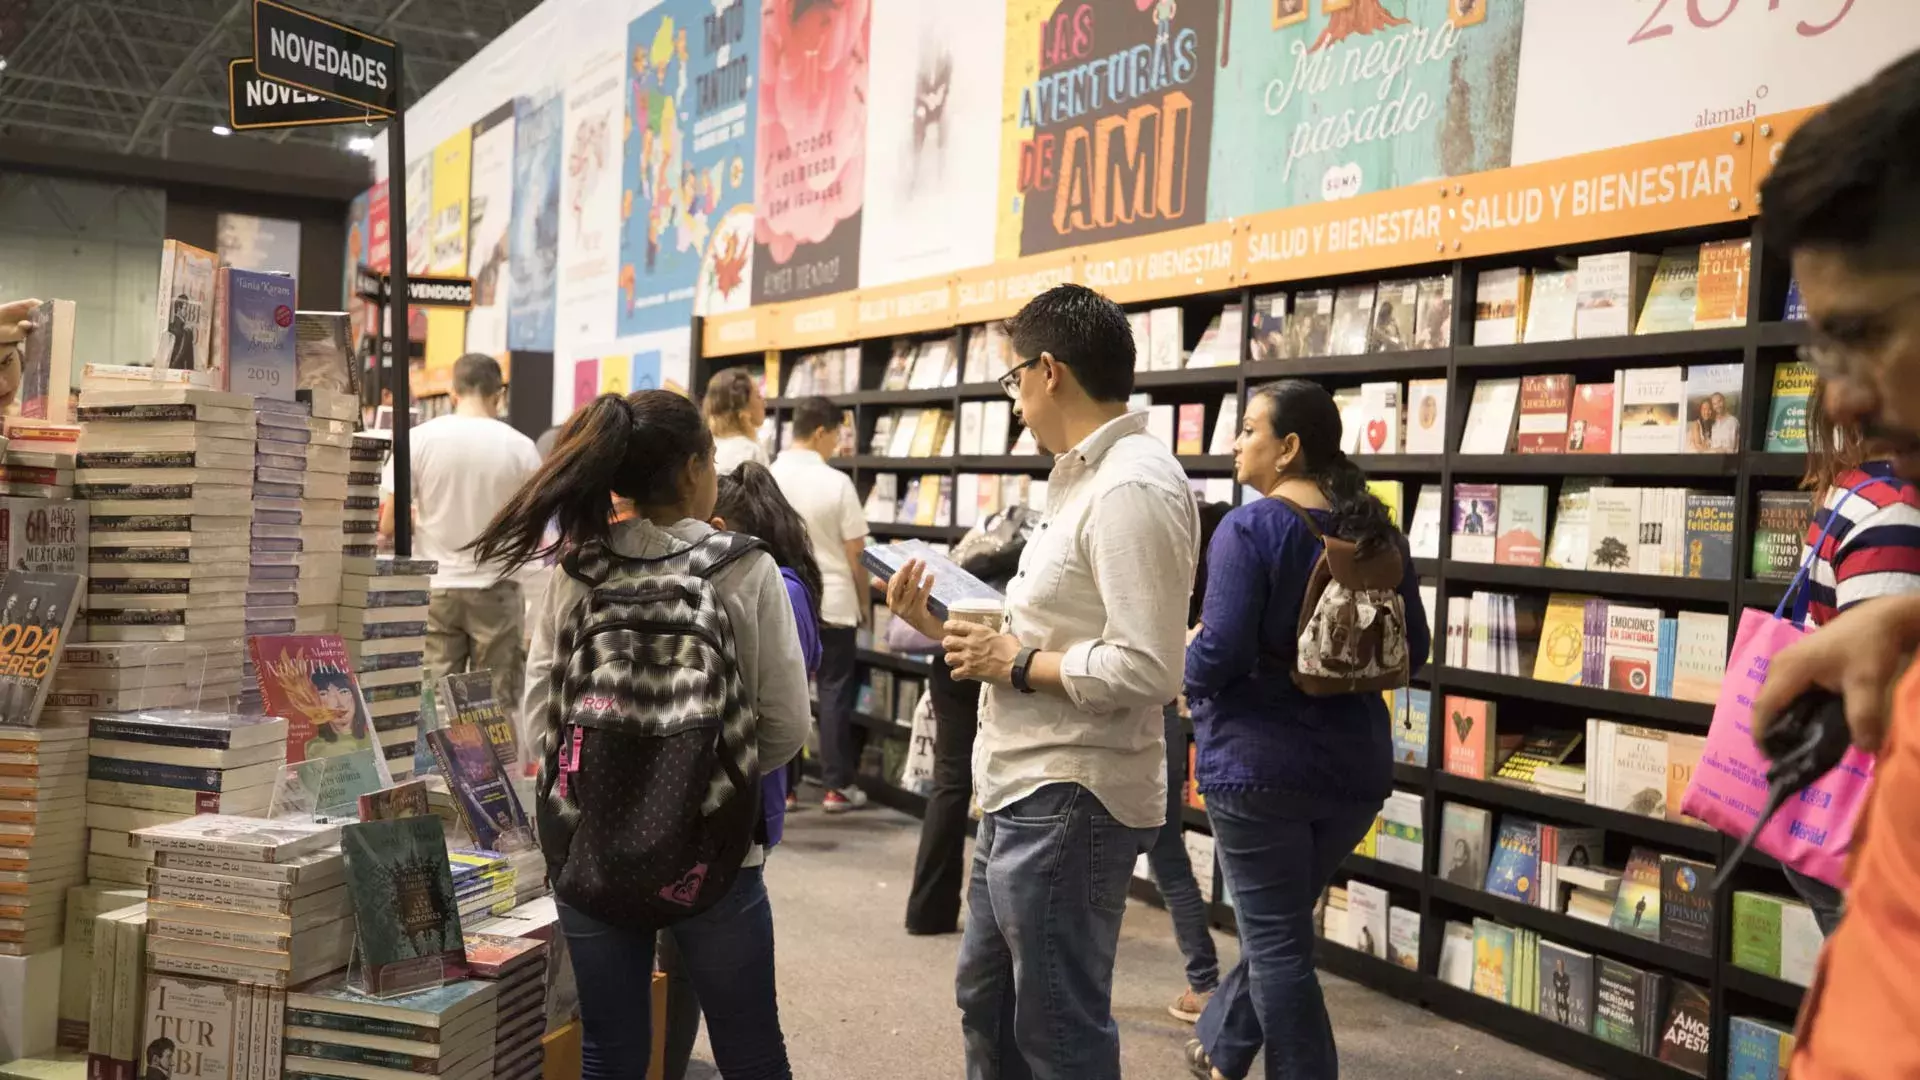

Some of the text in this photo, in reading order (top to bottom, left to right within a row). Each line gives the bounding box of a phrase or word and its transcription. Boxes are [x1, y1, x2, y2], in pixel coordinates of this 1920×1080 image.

[1039, 4, 1095, 70] LAS
[270, 27, 387, 90] NOVEDADES
[1264, 18, 1463, 116] Mi negro
[1018, 28, 1198, 129] AVENTURAS
[1694, 99, 1757, 128] alamah
[1281, 79, 1437, 184] pasado
[797, 156, 837, 181] BESOS
[1017, 133, 1056, 194] DE
[1052, 90, 1193, 235] AMI
[1326, 174, 1358, 191] SUMA
[1461, 187, 1543, 233] SALUD
[1550, 182, 1567, 220] Y
[1572, 154, 1734, 217] BIENESTAR
[1248, 205, 1441, 264] SALUD Y BIENESTAR
[1136, 256, 1144, 280] Y
[1147, 240, 1233, 281] BIENESTAR
[411, 283, 472, 301] VENDIDOS
[247, 367, 280, 386] 2019
[26, 509, 49, 544] 60
[1688, 520, 1733, 532] felicidad
[1696, 507, 1719, 519] ABC
[26, 547, 76, 563] MEXICANO
[1768, 556, 1793, 567] DIOS?
[1610, 615, 1655, 632] EMOCIONES
[1501, 838, 1534, 857] VITAL
[1789, 819, 1827, 847] Herald
[1599, 990, 1635, 1011] HERIDAS
[155, 1014, 214, 1047] TUR
[1674, 1011, 1709, 1041] AMOR
[175, 1048, 204, 1077] BI
